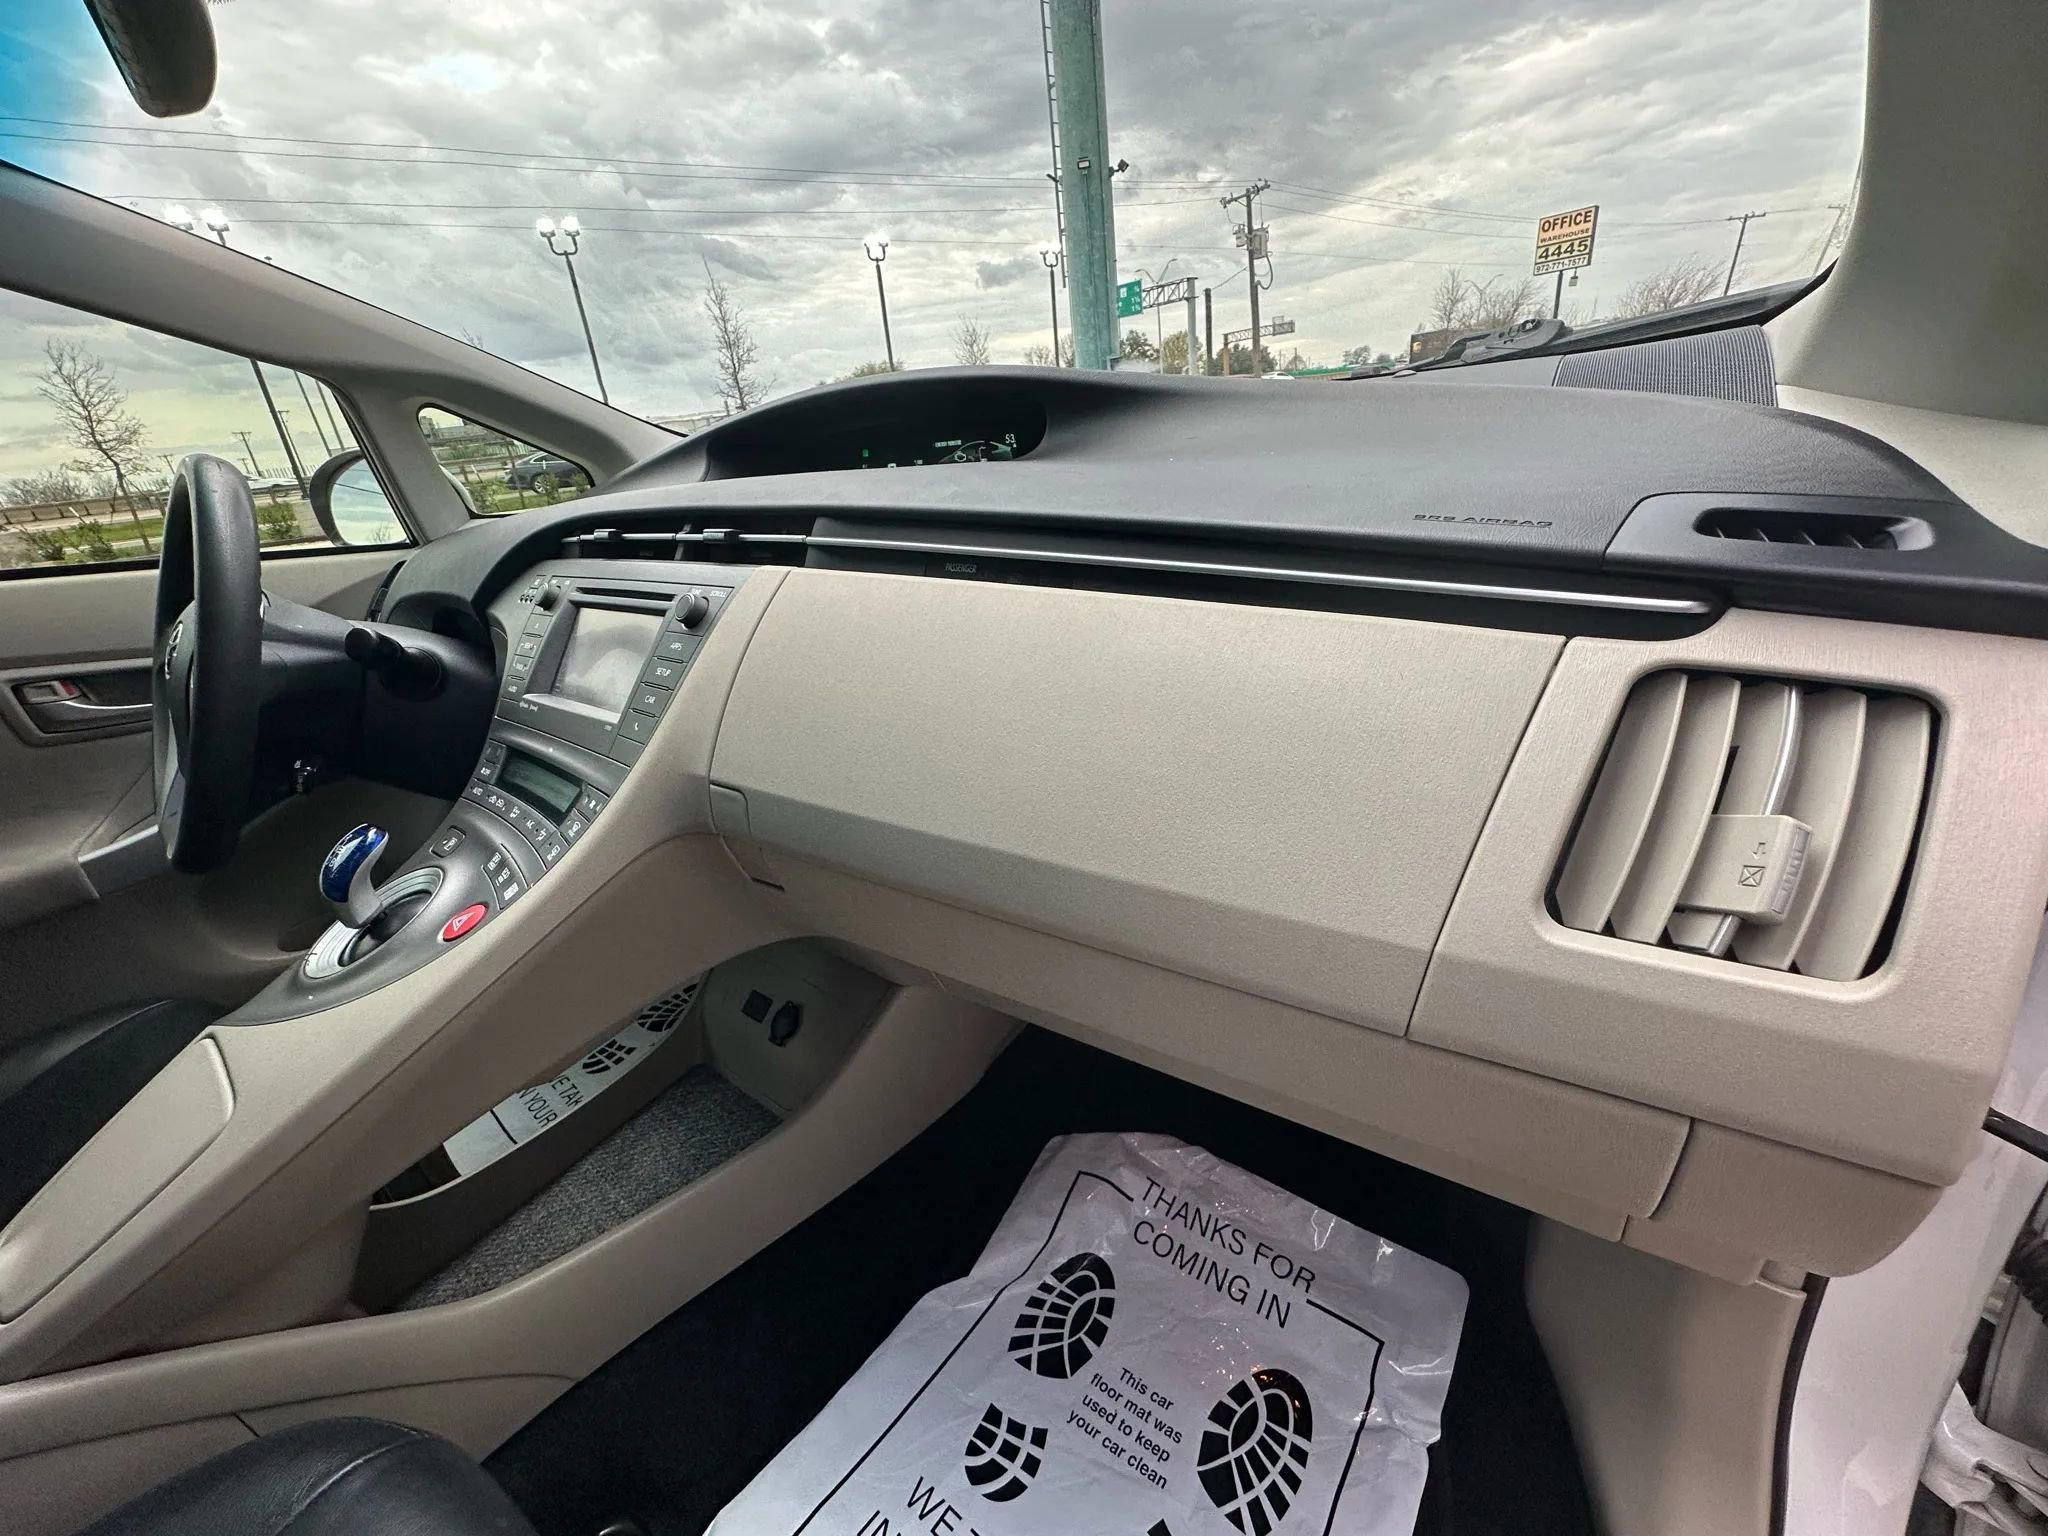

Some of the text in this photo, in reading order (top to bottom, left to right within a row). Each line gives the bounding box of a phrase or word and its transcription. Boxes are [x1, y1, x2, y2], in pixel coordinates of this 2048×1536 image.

[1540, 227, 1590, 244] WAREHOUSE
[1541, 210, 1593, 233] OFFICE
[1536, 256, 1587, 273] 972-771-7577
[1538, 239, 1589, 260] 4445
[1463, 517, 1553, 528] AIRBAG
[524, 1091, 559, 1128] YOUR
[558, 1083, 585, 1107] TAK
[1142, 1175, 1316, 1294] THANKS FOR
[1133, 1220, 1292, 1329] COMING IN
[1090, 1373, 1183, 1444] floor mat was
[1119, 1367, 1175, 1411] This car
[1082, 1394, 1171, 1463] used to keep
[1066, 1409, 1168, 1490] your car clean
[907, 1475, 963, 1536] WE
